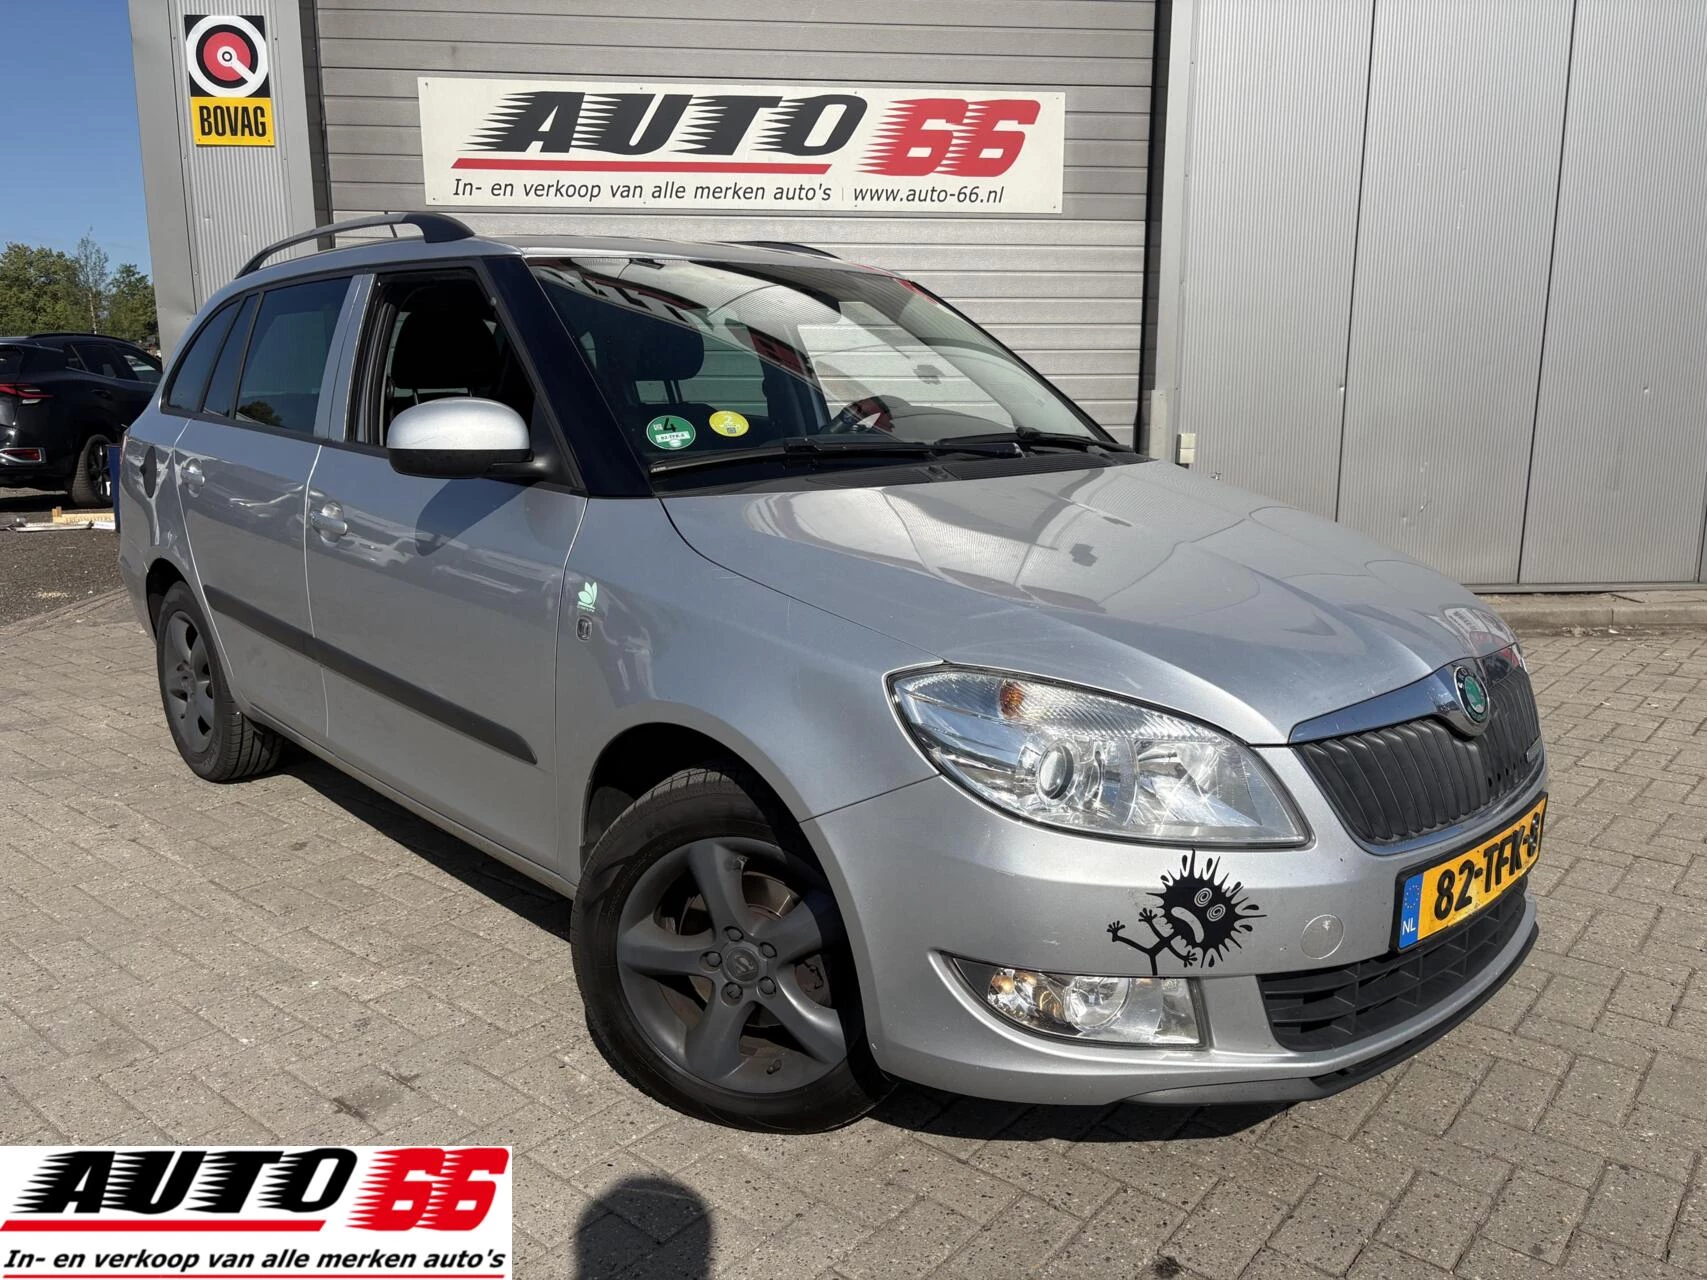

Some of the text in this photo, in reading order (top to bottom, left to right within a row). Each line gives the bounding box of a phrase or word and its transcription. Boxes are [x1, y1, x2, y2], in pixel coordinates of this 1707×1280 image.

[198, 105, 267, 137] BOVAG
[458, 90, 1041, 177] AUTO 66
[453, 178, 1005, 204] In- en verkoop van alle merken auto's www.auto-66.nl
[663, 417, 676, 432] 4
[1402, 917, 1416, 935] NL
